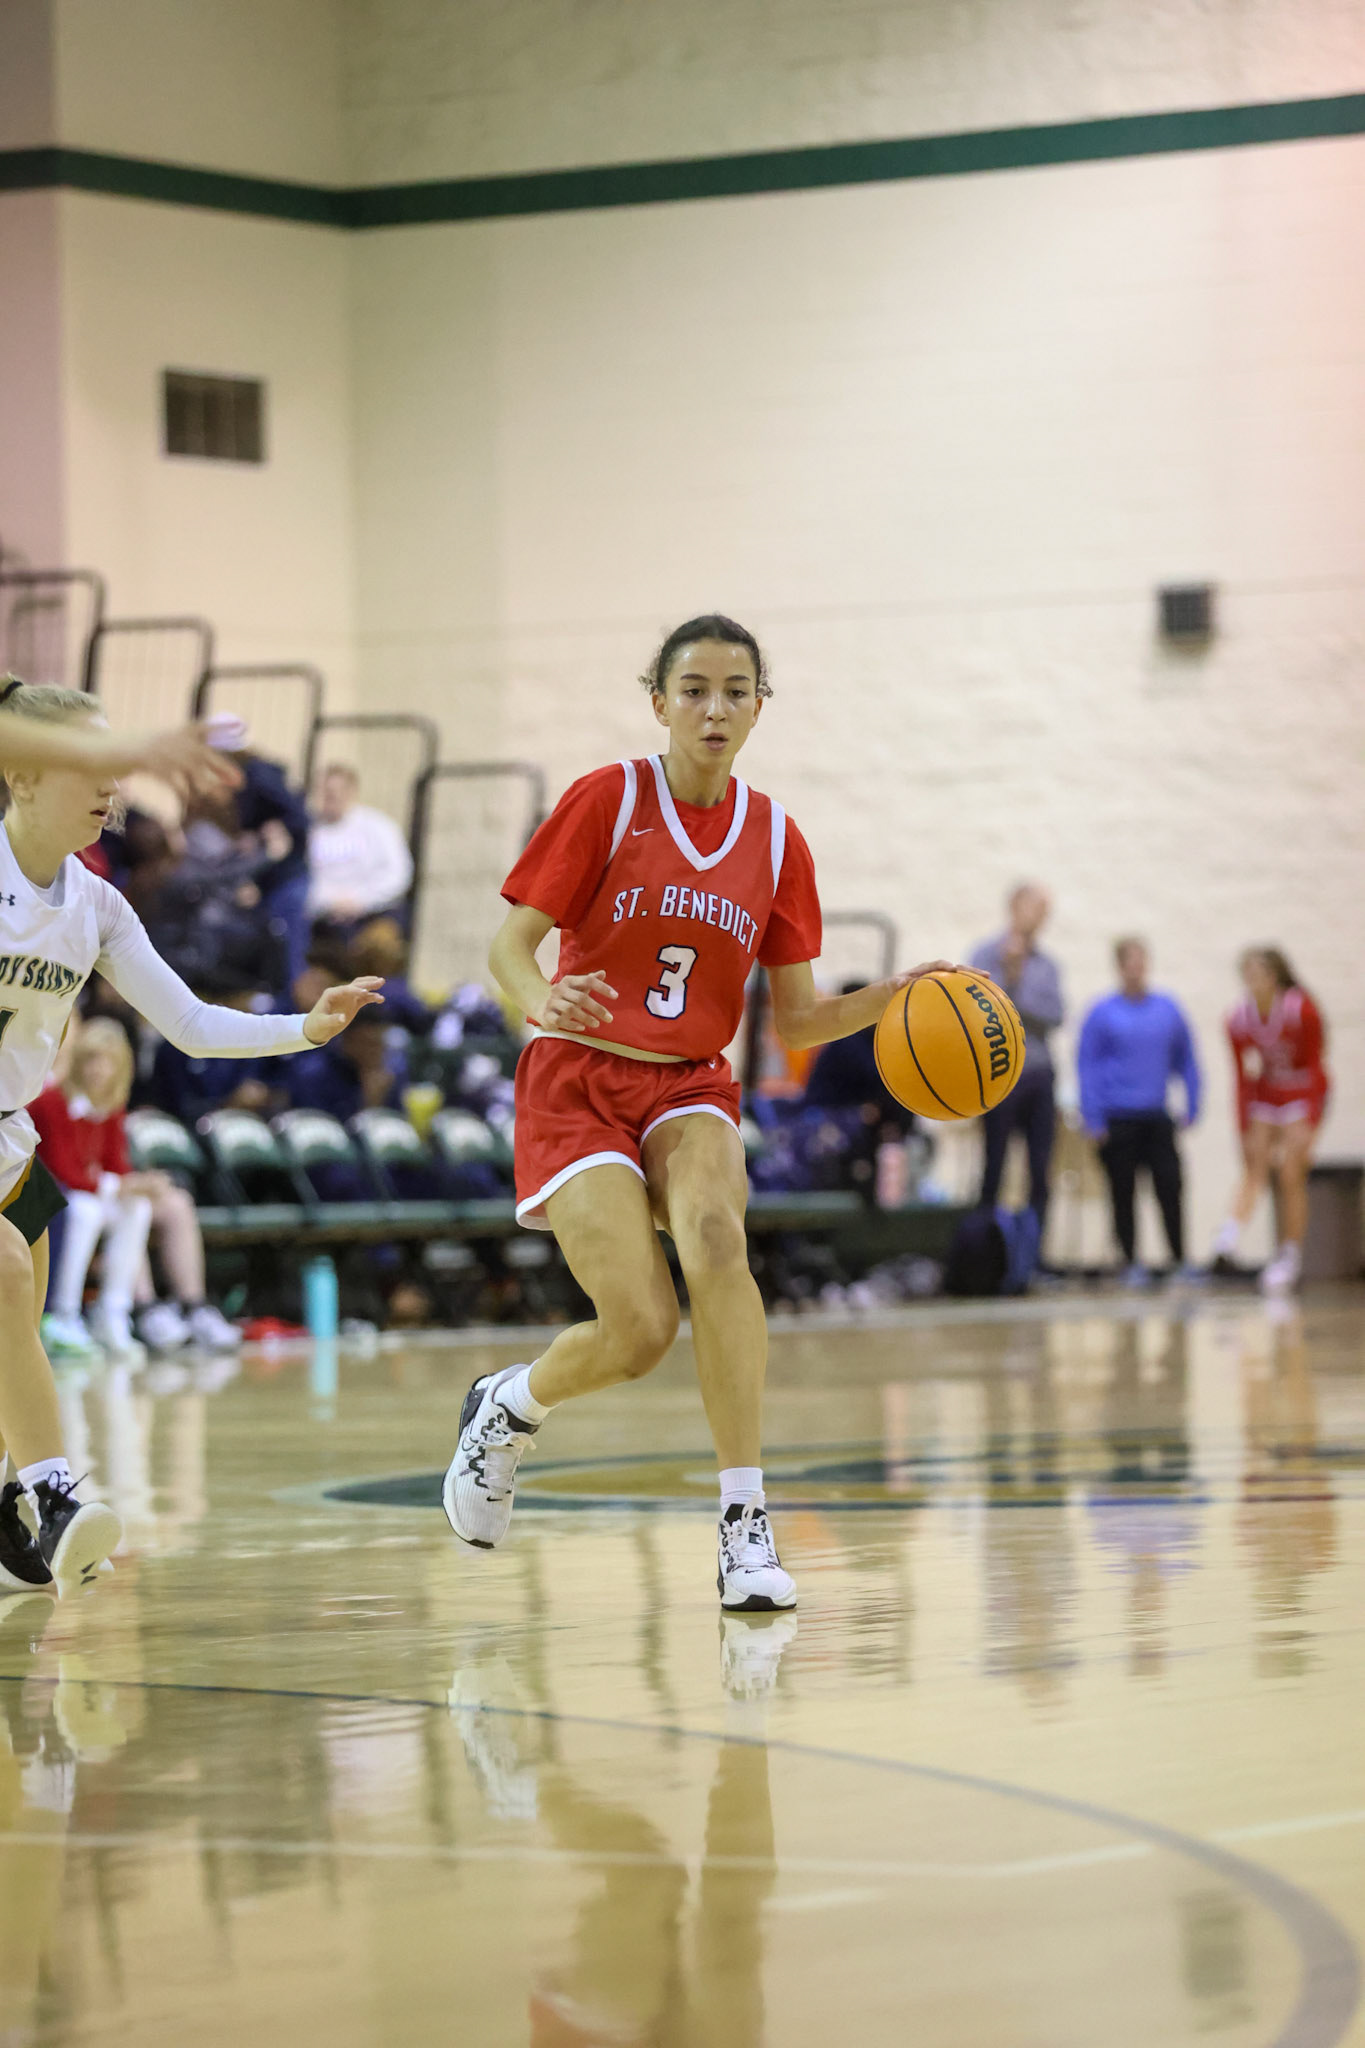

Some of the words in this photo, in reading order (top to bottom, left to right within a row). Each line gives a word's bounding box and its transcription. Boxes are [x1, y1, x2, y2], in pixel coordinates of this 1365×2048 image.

[612, 886, 648, 923] ST.
[659, 885, 758, 954] BENEDICT
[645, 944, 698, 1020] 3
[965, 983, 1011, 1081] Wilson
